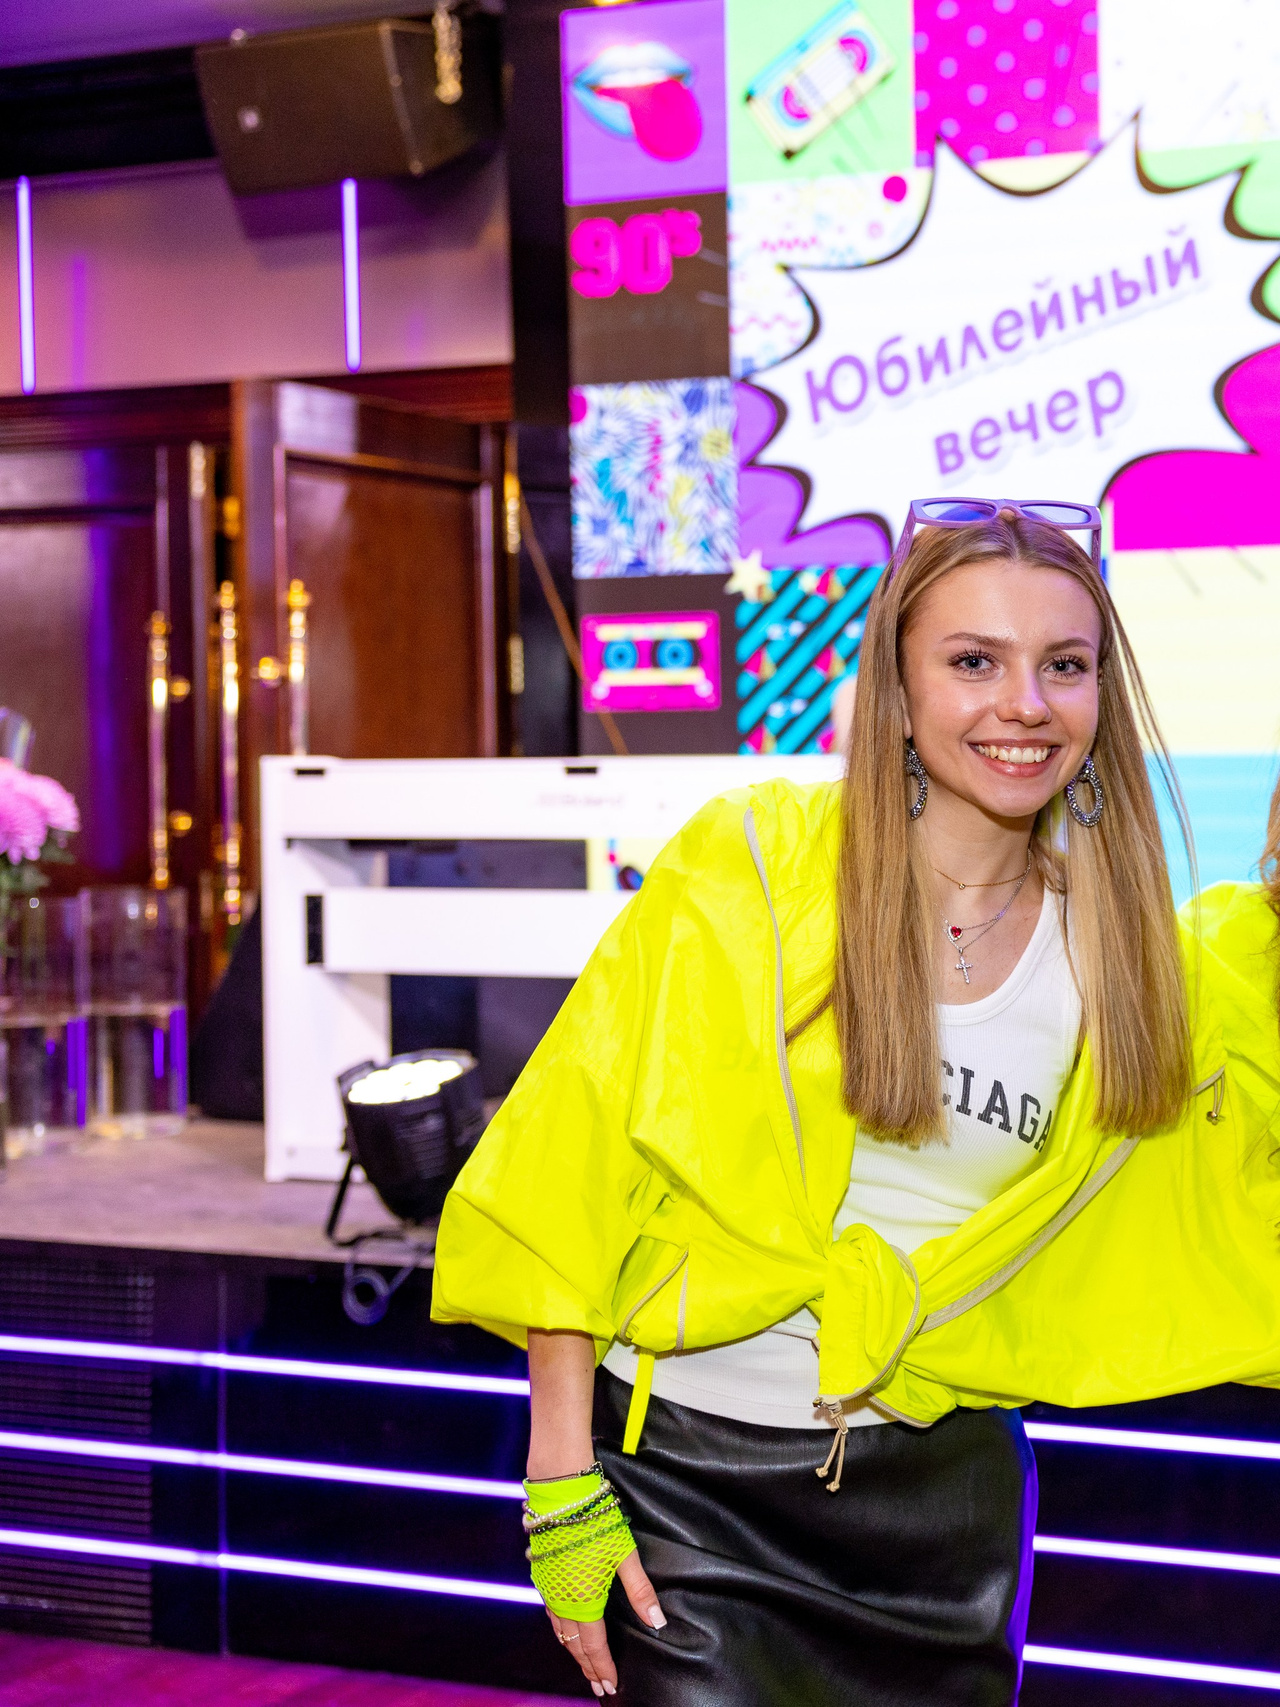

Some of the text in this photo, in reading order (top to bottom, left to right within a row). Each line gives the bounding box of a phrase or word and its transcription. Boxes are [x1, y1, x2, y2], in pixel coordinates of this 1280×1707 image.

[806, 224, 1201, 424] Юбилейный
[934, 370, 1125, 476] вечер
[942, 1059, 1053, 1153] CIAGA
